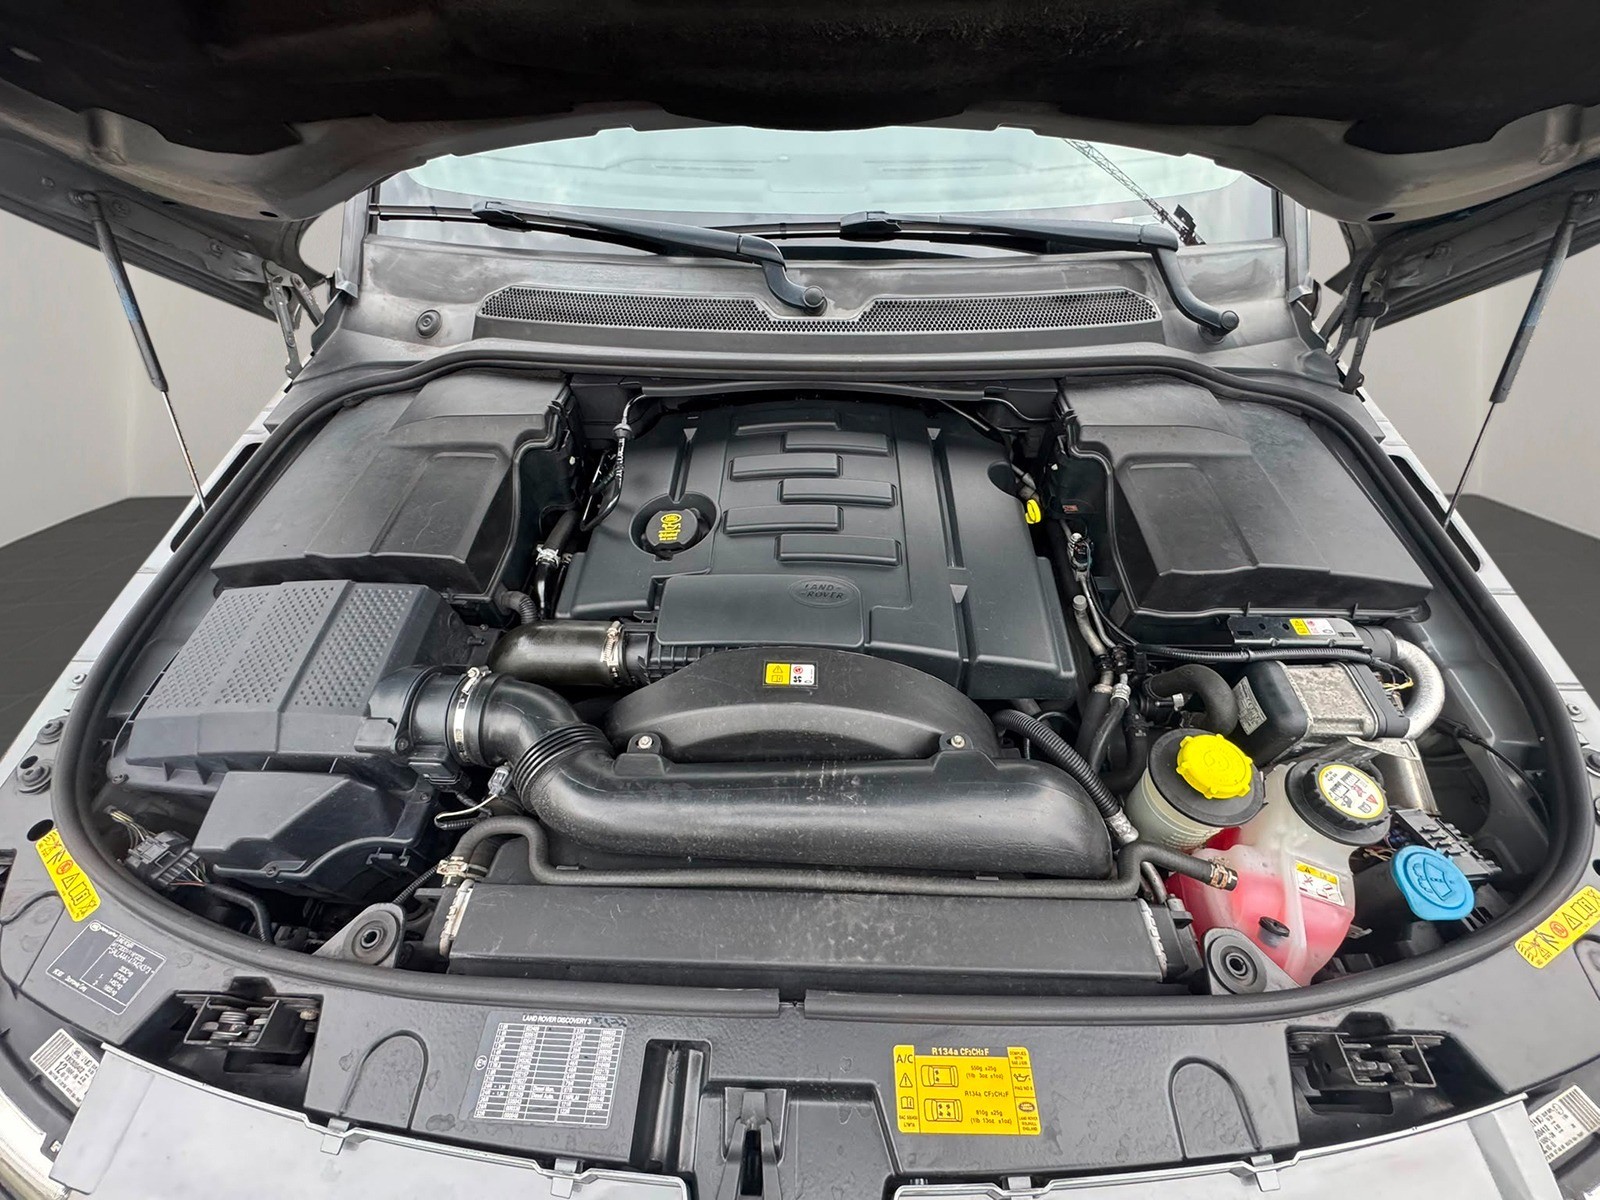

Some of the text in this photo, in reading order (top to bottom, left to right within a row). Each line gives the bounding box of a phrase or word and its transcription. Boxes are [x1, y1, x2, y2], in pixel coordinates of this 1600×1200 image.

[804, 583, 834, 591] LAND
[806, 591, 845, 599] ROVER
[522, 1014, 538, 1022] LAND
[538, 1015, 557, 1023] ROVER
[557, 1016, 587, 1025] DISCOVERY
[931, 1047, 959, 1056] R134a
[896, 1054, 914, 1064] A/C
